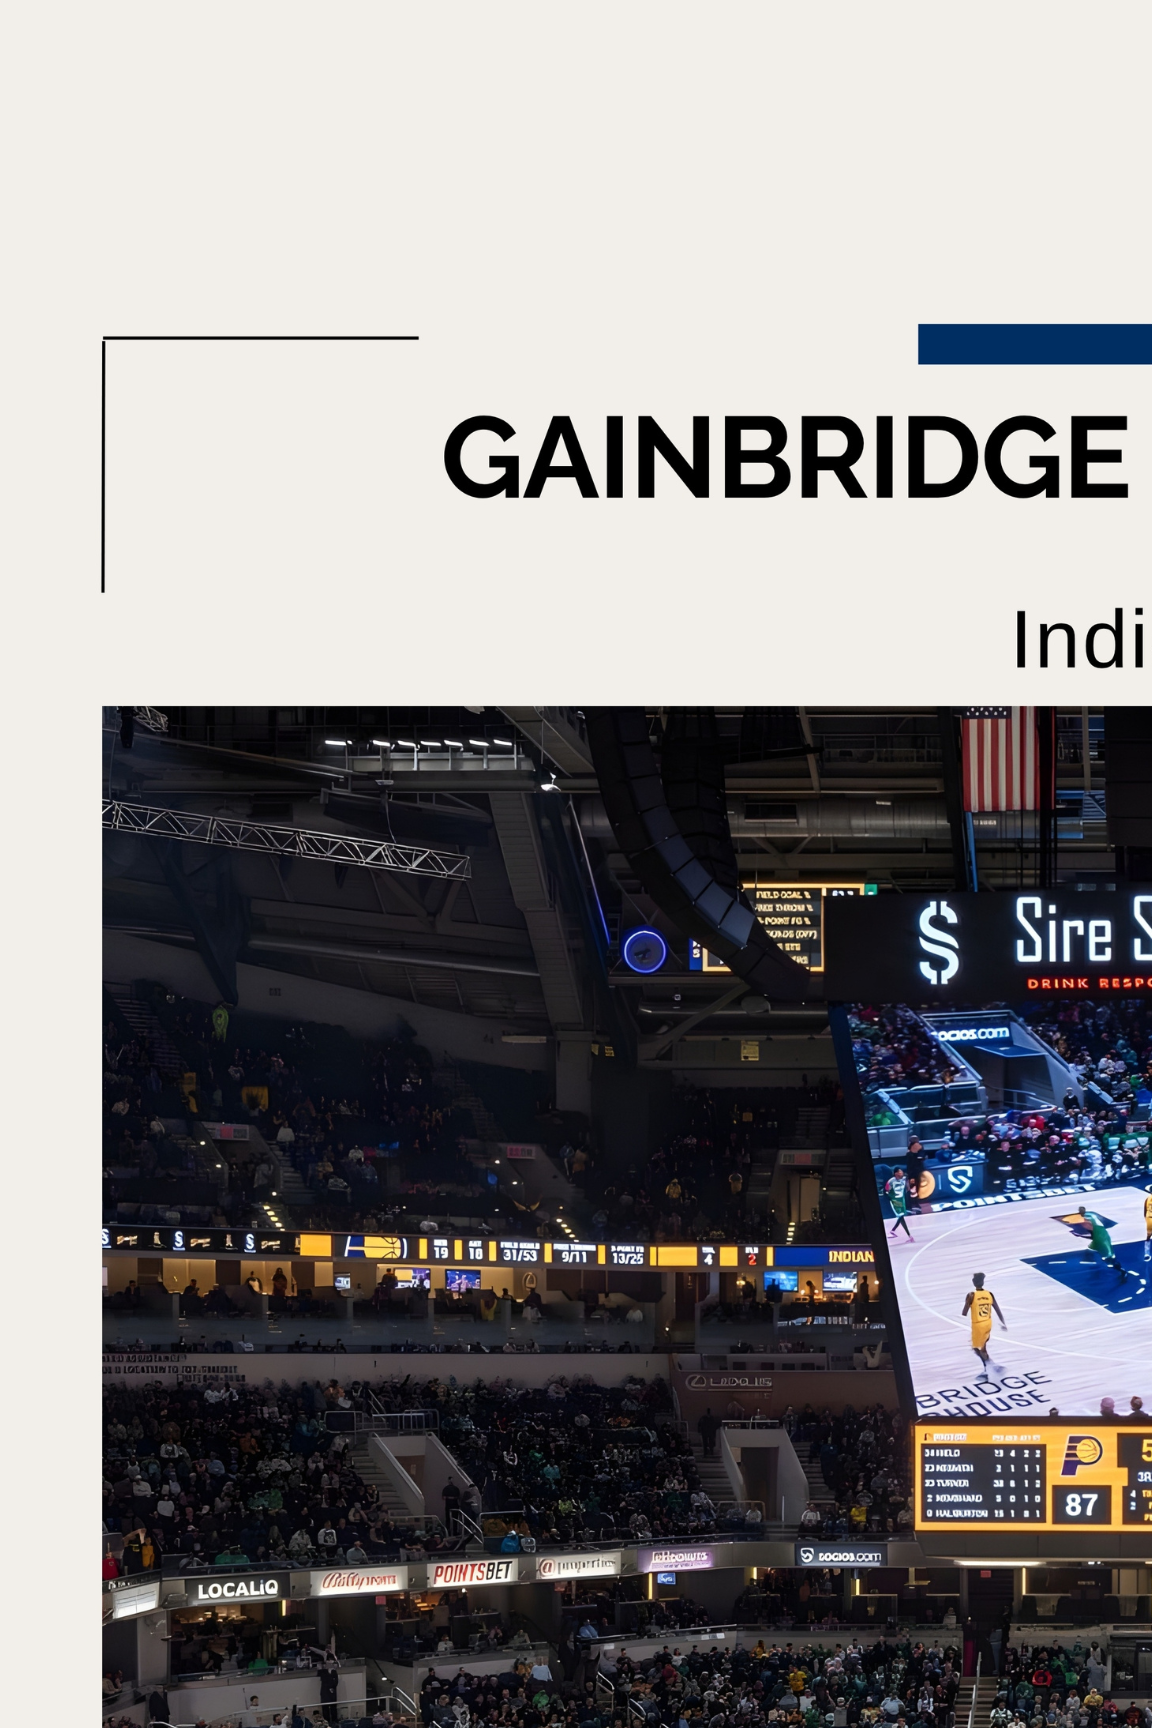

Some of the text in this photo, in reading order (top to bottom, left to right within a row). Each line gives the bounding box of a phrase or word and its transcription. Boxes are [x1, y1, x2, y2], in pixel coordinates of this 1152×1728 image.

[1015, 896, 1112, 963] Sire
[1027, 978, 1089, 990] DRINK
[1065, 1493, 1098, 1518] 87
[432, 1560, 513, 1585] POINTSBET
